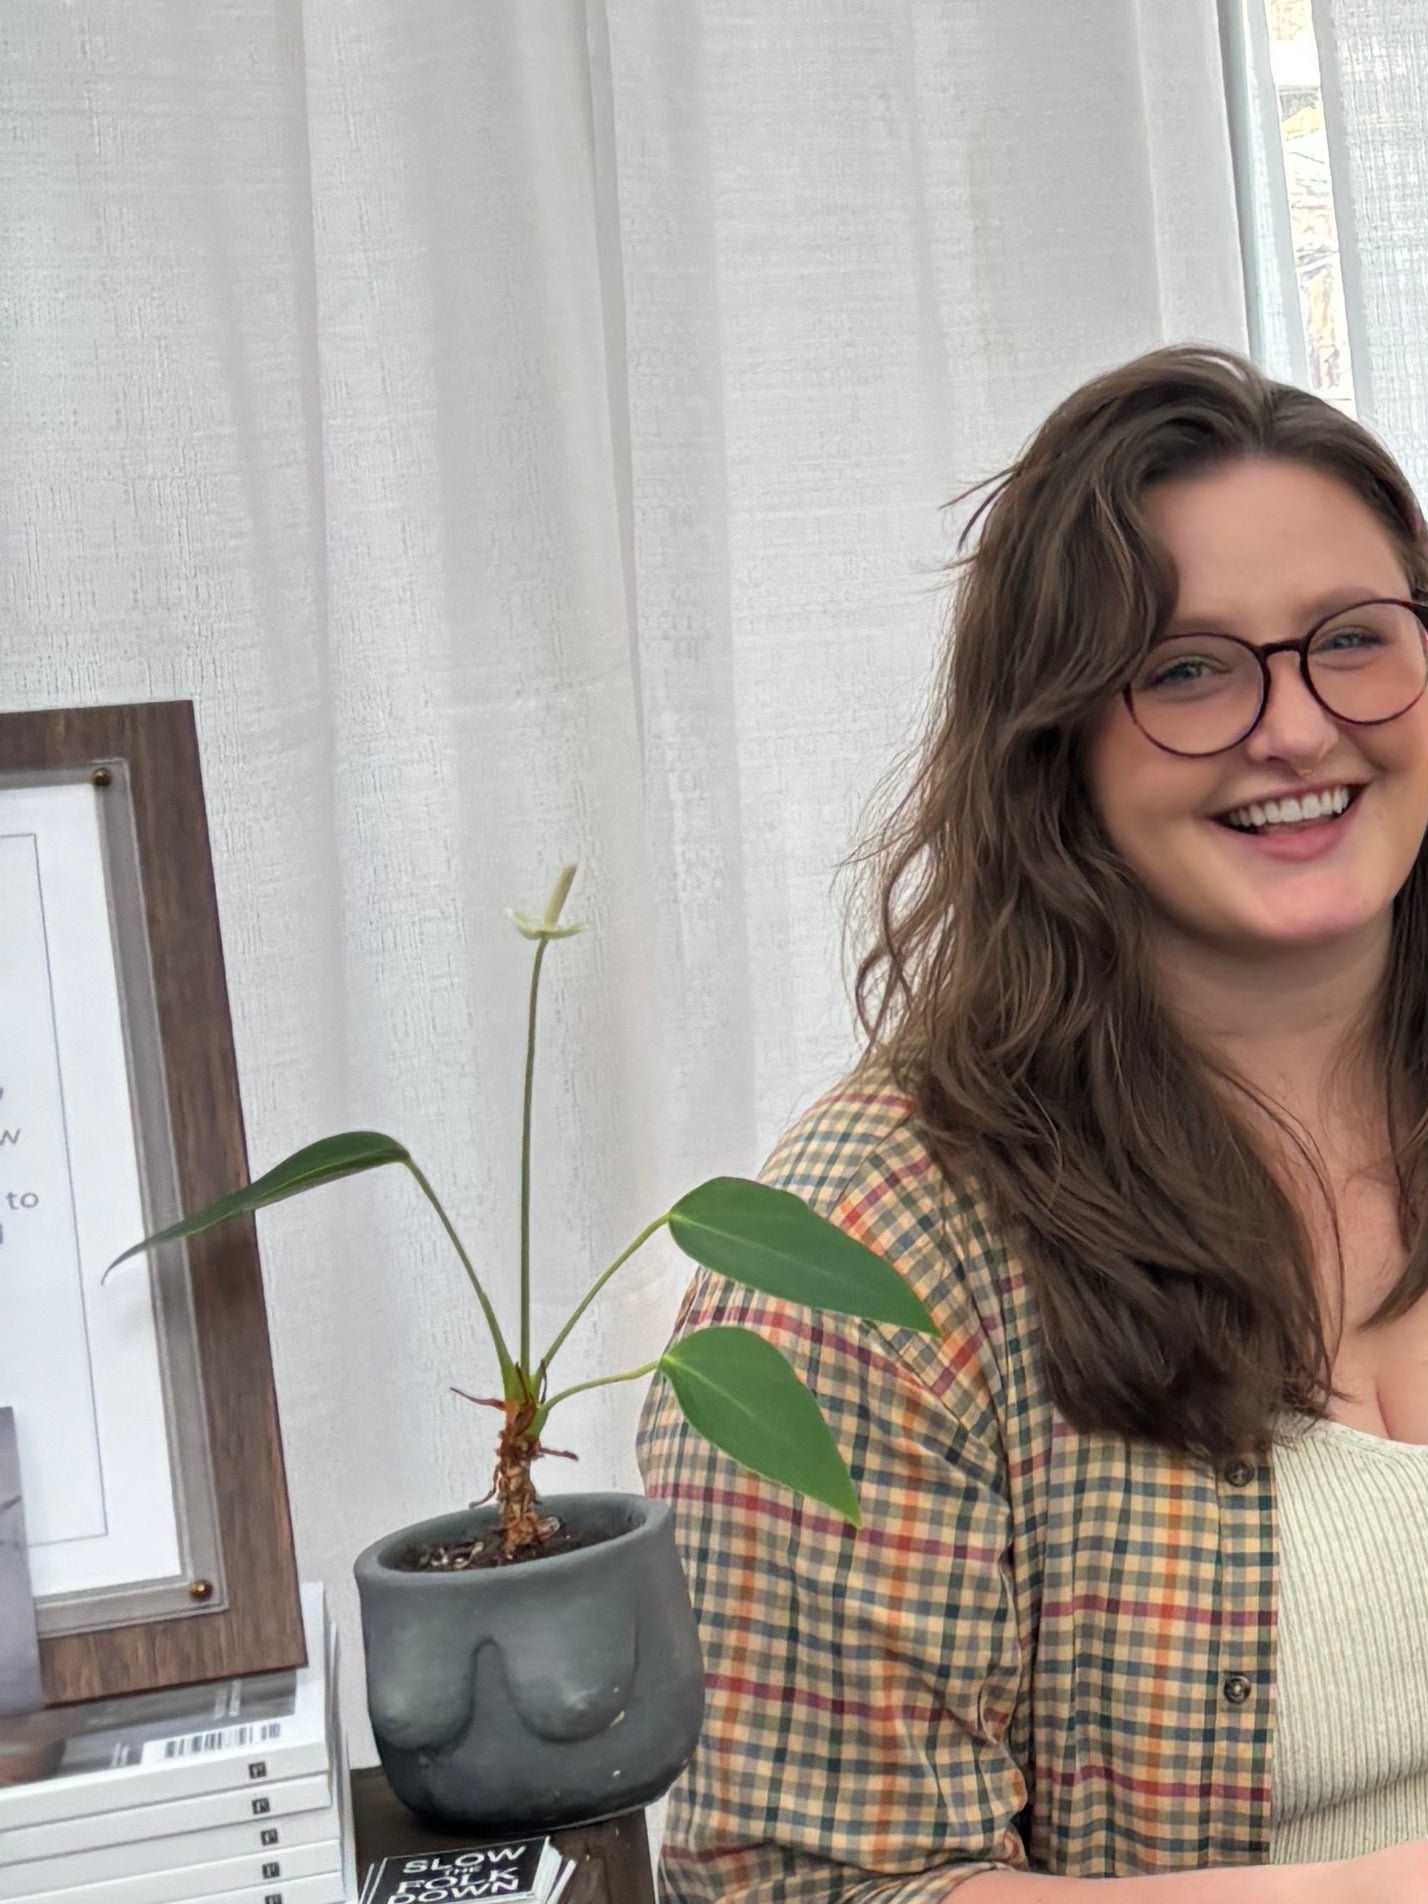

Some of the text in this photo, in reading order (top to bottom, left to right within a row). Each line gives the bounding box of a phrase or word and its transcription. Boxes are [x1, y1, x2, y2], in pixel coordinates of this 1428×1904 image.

[7, 1191, 39, 1210] to
[402, 1845, 527, 1874] SLOW
[444, 1865, 483, 1876] THE
[397, 1866, 519, 1895] FOLK
